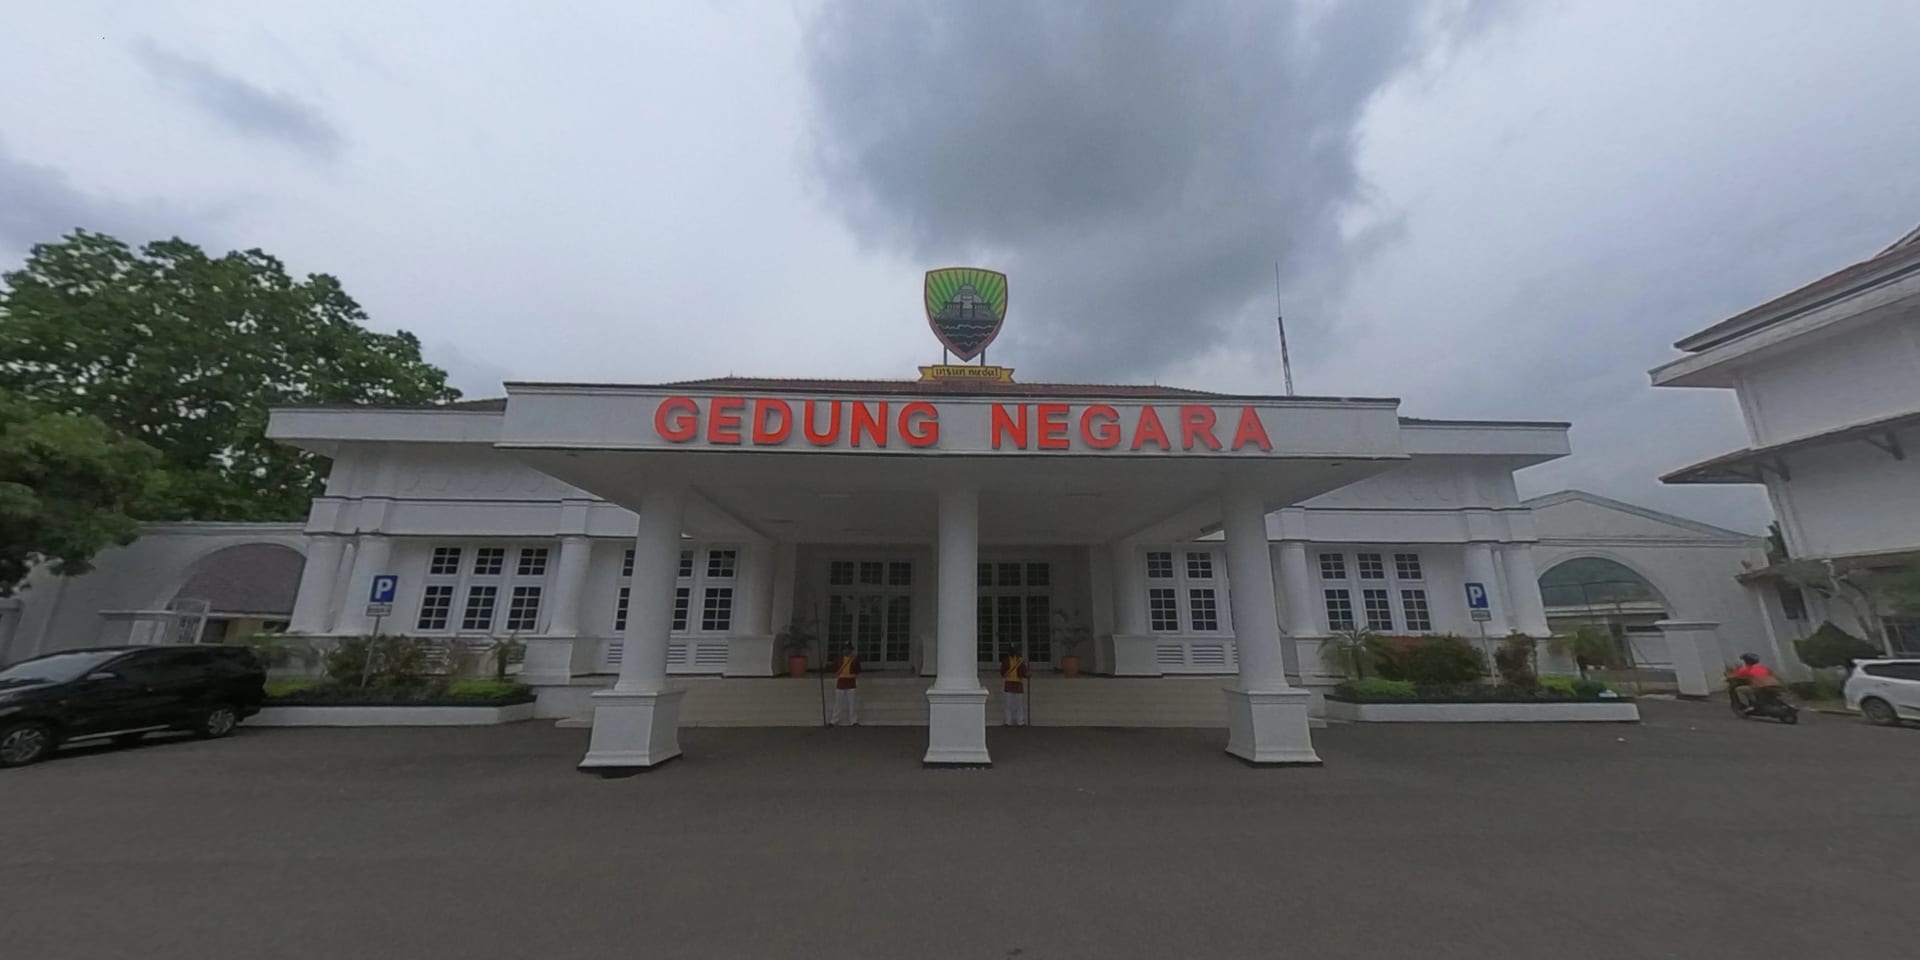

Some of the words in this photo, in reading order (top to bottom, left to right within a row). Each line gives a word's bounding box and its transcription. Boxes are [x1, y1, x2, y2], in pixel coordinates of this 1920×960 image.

[654, 395, 939, 447] GEDUNG
[991, 402, 1272, 450] NEGARA
[375, 578, 393, 599] P
[1469, 586, 1482, 605] P
